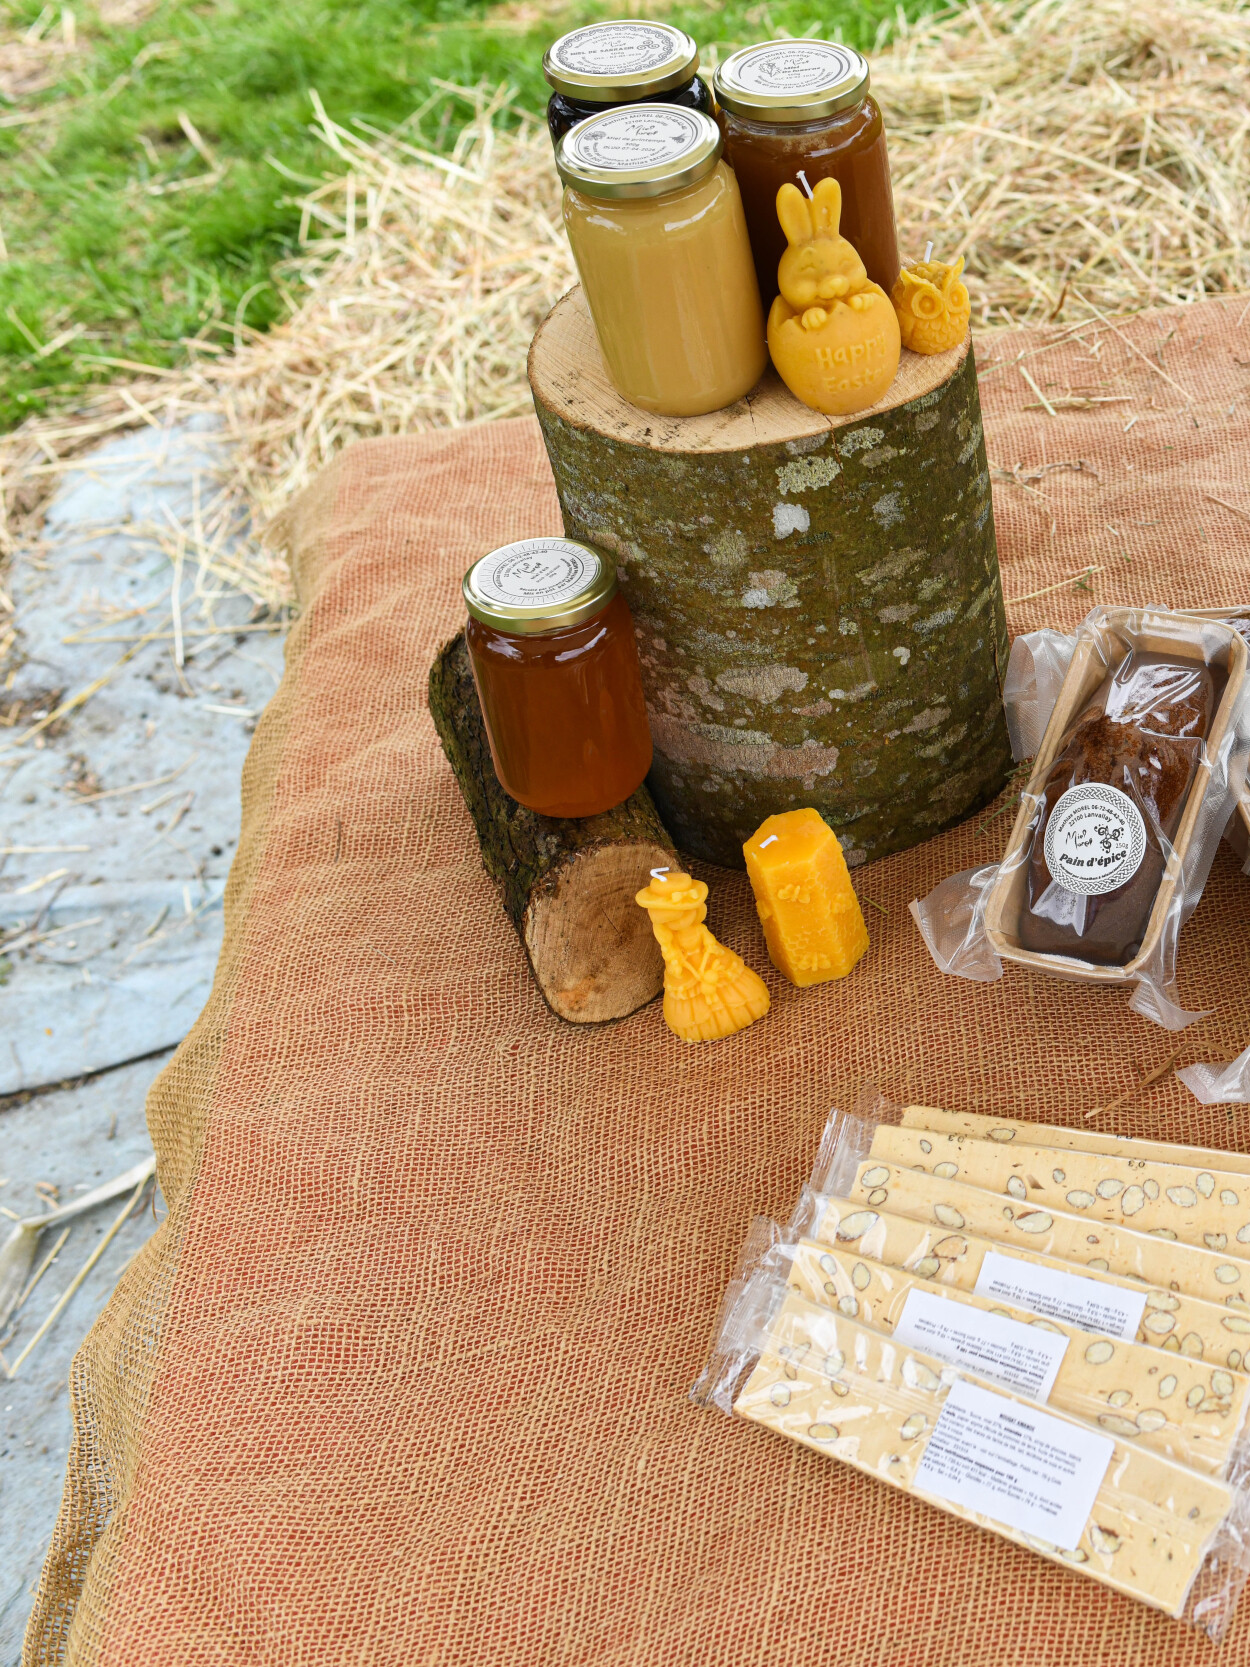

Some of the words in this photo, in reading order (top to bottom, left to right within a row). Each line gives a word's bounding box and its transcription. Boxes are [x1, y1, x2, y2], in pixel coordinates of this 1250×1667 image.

[816, 332, 886, 370] Happy
[822, 364, 886, 394] Easte
[1059, 813, 1074, 832] Mathias
[1073, 804, 1091, 815] MOREL
[1068, 814, 1084, 827] 22100
[1084, 812, 1112, 822] Lanvallay
[1059, 853, 1085, 867] Pain
[1086, 850, 1127, 868] d'épice
